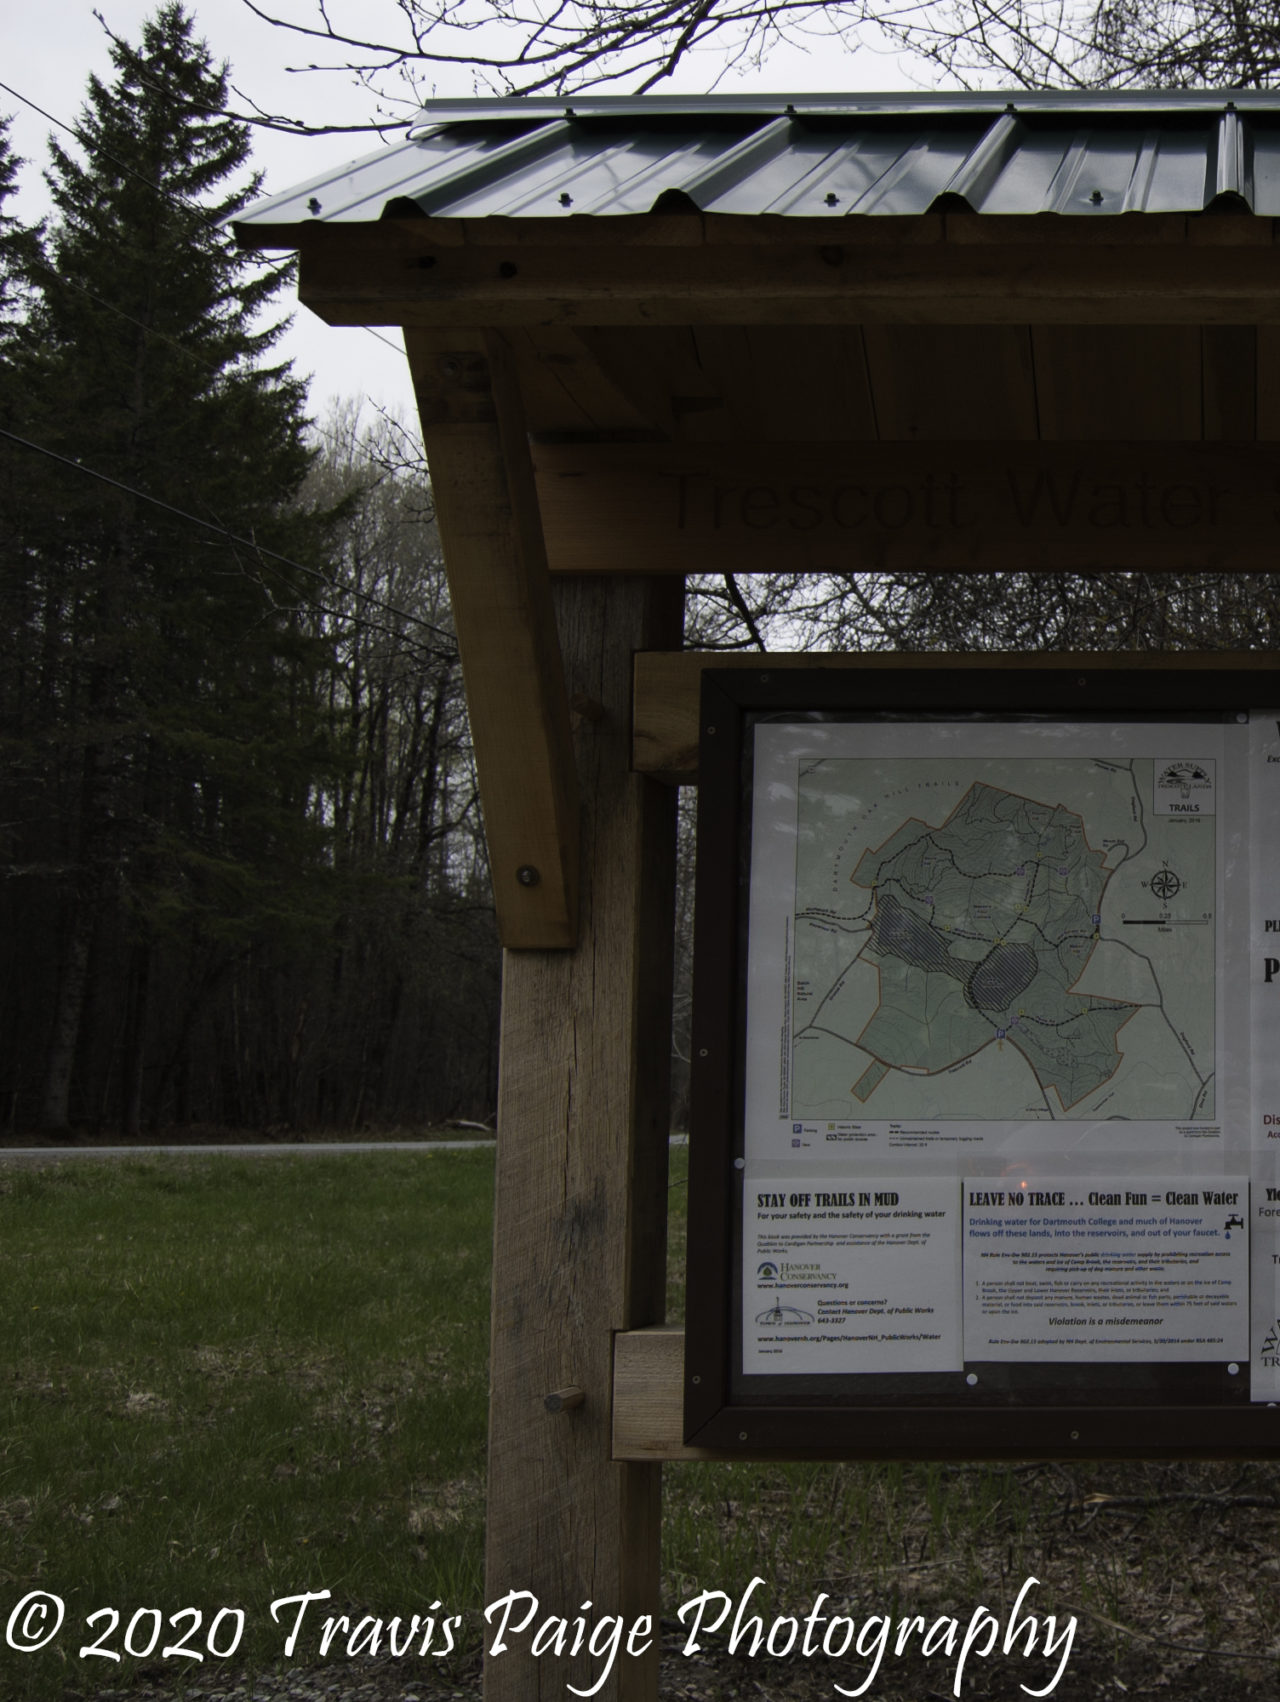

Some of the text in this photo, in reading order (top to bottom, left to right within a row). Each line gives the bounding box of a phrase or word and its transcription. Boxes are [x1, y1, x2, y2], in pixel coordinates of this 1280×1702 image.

[657, 468, 977, 530] Trescott
[1005, 467, 1237, 530] Water
[1169, 804, 1200, 812] TRAILS
[757, 1192, 899, 1208] STAY OFF TRAILS IN MUD
[969, 1192, 1005, 1206] LEAVE
[1008, 1192, 1024, 1206] NO
[1027, 1192, 1065, 1206] TRACE
[1088, 1192, 1121, 1206] Clean
[1125, 1192, 1147, 1206] Fun
[1165, 1191, 1199, 1205] Clean
[1202, 1191, 1239, 1205] Water
[969, 1216, 1203, 1227] Drinking water for Dartmouth College and much of Hanover
[1049, 1317, 1087, 1326] Violation
[1088, 1317, 1096, 1325] is
[1105, 1317, 1164, 1325] misdemeanor
